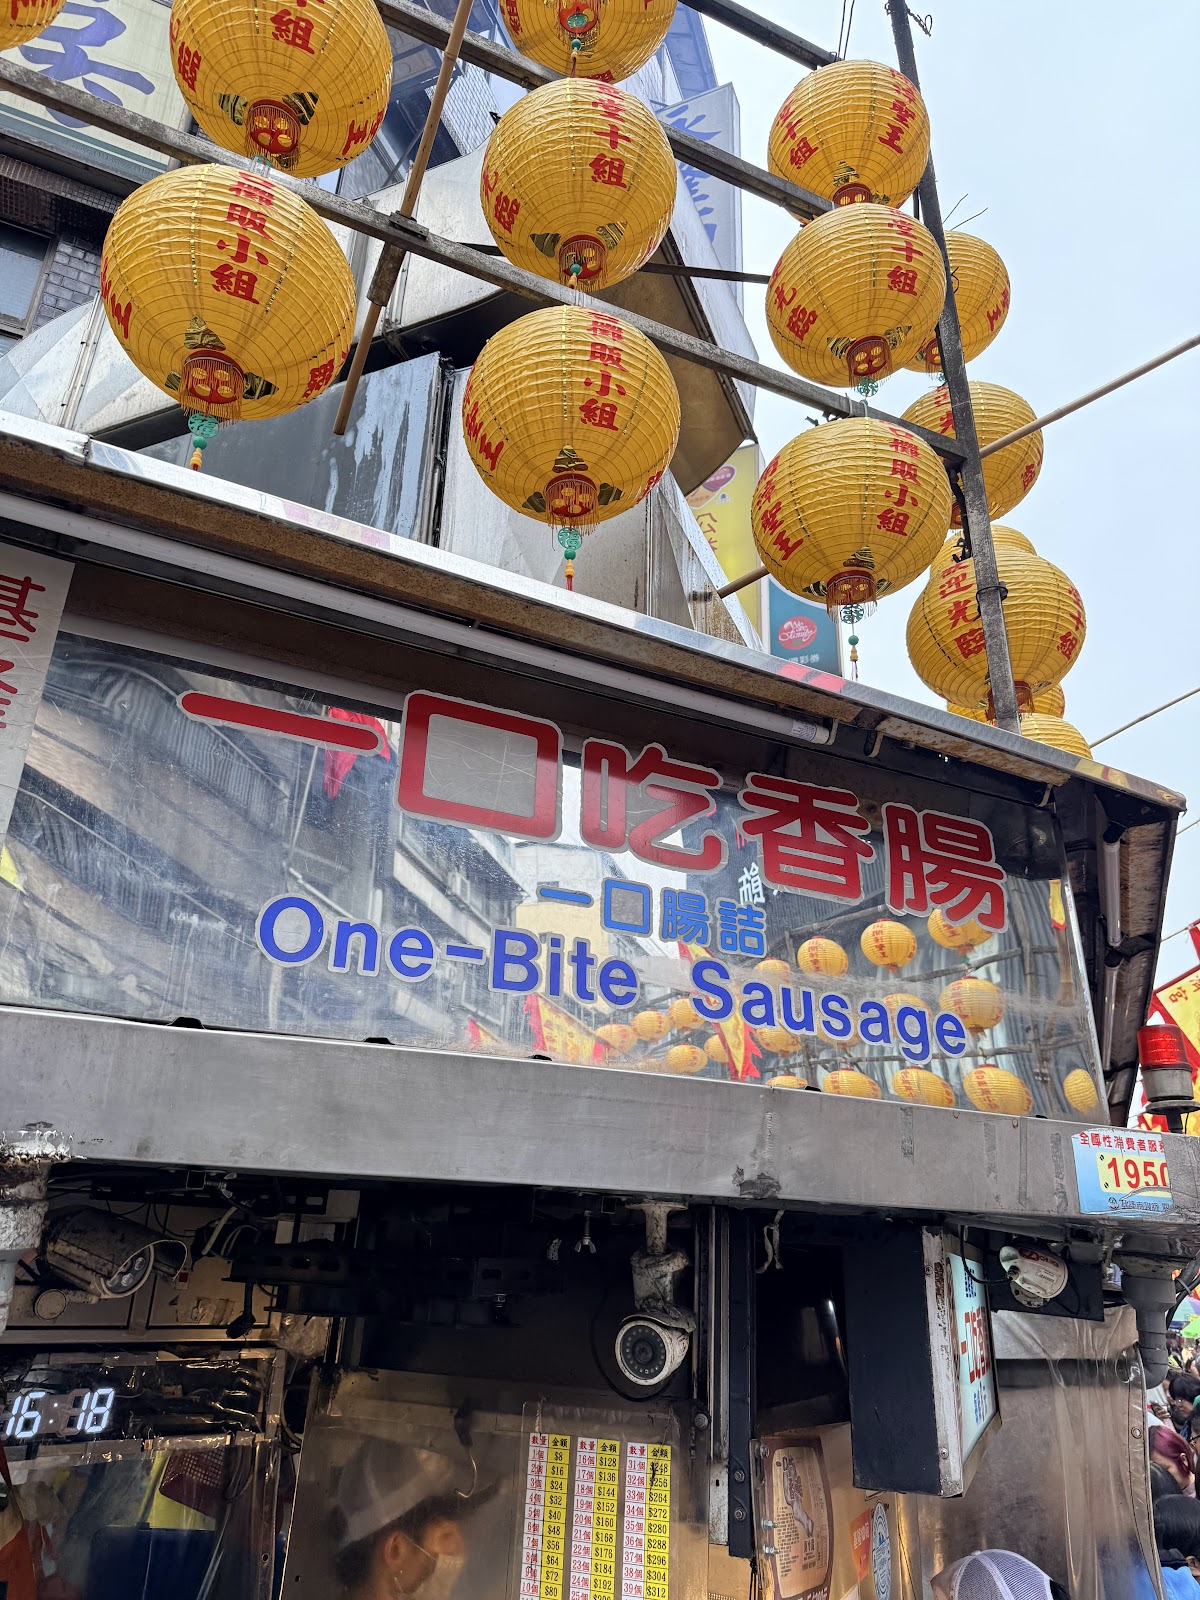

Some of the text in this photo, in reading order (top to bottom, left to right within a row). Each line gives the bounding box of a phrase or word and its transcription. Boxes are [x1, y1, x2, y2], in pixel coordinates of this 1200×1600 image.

[270, 0, 324, 55] 組
[182, 692, 1006, 930] 一口吃香腸
[540, 879, 765, 956] 一口腸詰
[260, 896, 966, 1062] One-Bite Sausage
[6, 1388, 115, 1438] 16:18
[532, 1435, 567, 1448] 數量 金額
[580, 1440, 616, 1453] 數量 金額
[554, 1451, 563, 1461] $8
[629, 1445, 668, 1458] 數量 金額
[599, 1457, 616, 1467] $128
[551, 1466, 563, 1476] $16
[598, 1471, 616, 1482] $136
[550, 1480, 563, 1490] $24
[597, 1487, 615, 1497] $144
[649, 1492, 667, 1503] $264
[549, 1495, 562, 1506] $32
[597, 1501, 615, 1512] $152
[549, 1510, 561, 1520] $40
[648, 1507, 667, 1518] $272
[596, 1516, 613, 1527] $160
[548, 1525, 560, 1535] $48
[648, 1523, 666, 1534] $280
[595, 1532, 613, 1543] $168
[547, 1540, 559, 1550] $56
[648, 1539, 666, 1550] $288
[595, 1547, 612, 1558] $176
[546, 1555, 559, 1565] $64
[647, 1554, 666, 1565] $296
[594, 1563, 612, 1574] $184
[545, 1571, 558, 1581] $72
[647, 1570, 666, 1581] $304
[594, 1578, 612, 1590] $192
[545, 1586, 557, 1597] $80
[646, 1586, 665, 1598] $312
